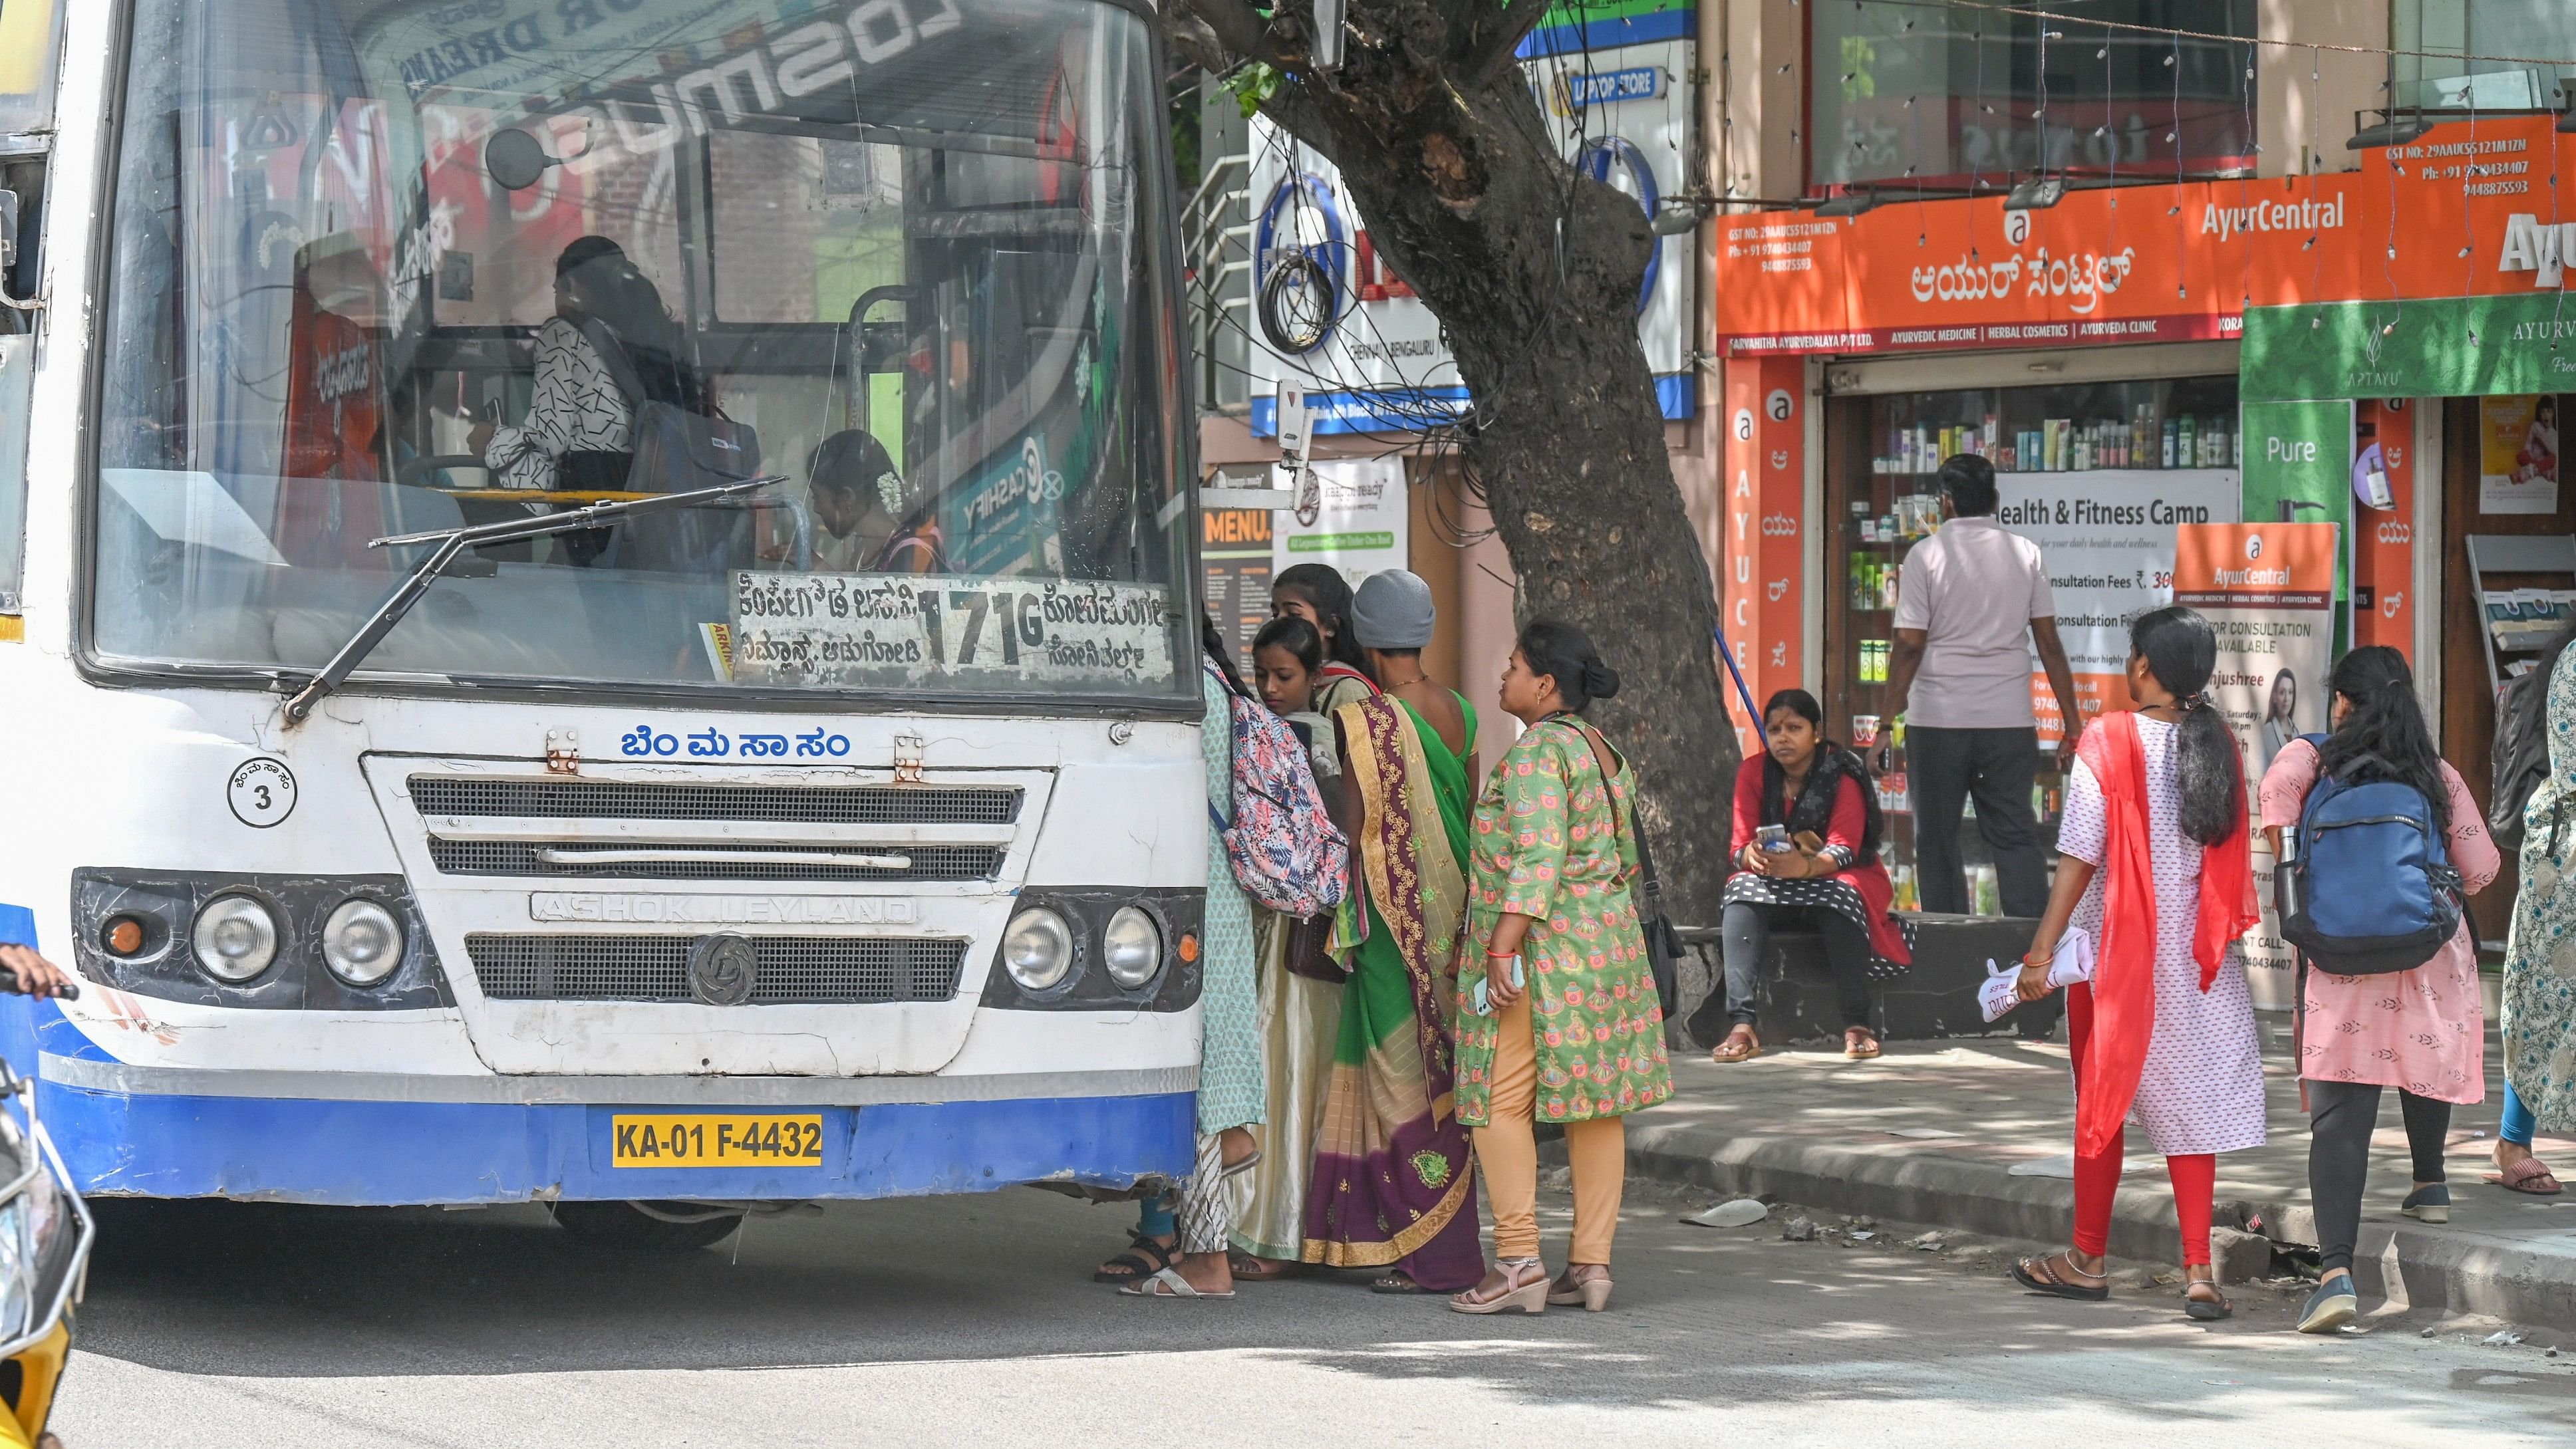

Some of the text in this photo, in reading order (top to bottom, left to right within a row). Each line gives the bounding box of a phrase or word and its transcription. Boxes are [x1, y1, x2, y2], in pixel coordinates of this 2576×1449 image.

[2386, 147, 2403, 160] GST
[2406, 146, 2424, 159] NO:
[2422, 168, 2439, 181] Ph:
[2442, 166, 2461, 179] +91
[2202, 191, 2344, 243] AyurCentral
[1912, 253, 2023, 302] ಆಯುರ್
[1892, 329, 1936, 344] AYURVEDIC
[1938, 327, 1977, 342] MEDICINE
[1989, 326, 2021, 339] HERBAL
[2023, 324, 2068, 338] COSMETICS
[2080, 321, 2127, 335] AYURVEDA
[2129, 319, 2157, 334] CLINIC
[1779, 334, 1839, 348] AYURVEDALAYA
[1857, 333, 1874, 346] LTD.
[2268, 436, 2316, 463] Pure
[1995, 499, 2210, 525] ealth & Fitness Camp
[1205, 509, 1271, 543] MENU.
[2108, 575, 2131, 589] Fees
[2214, 567, 2289, 589] AyurCentral
[2057, 613, 2118, 627] onsultation
[2231, 622, 2311, 638] CONSULTATION
[2217, 640, 2276, 654] AVAILABLE
[2070, 654, 2085, 664] with
[2101, 654, 2124, 666] highly
[2035, 680, 2047, 691] For
[2084, 682, 2097, 692] call
[2035, 697, 2059, 712] 9740
[2082, 698, 2102, 713] 407
[2035, 718, 2059, 731] 9448
[2240, 724, 2251, 733] pm
[621, 725, 851, 757] ಬೆಂ ಮ ಸಾ ಸಂ
[254, 785, 271, 810] 3
[541, 894, 916, 923] ASHOK LEYLAND
[2258, 937, 2285, 950] CALL:
[617, 1122, 822, 1158] KA-01 F-4432
